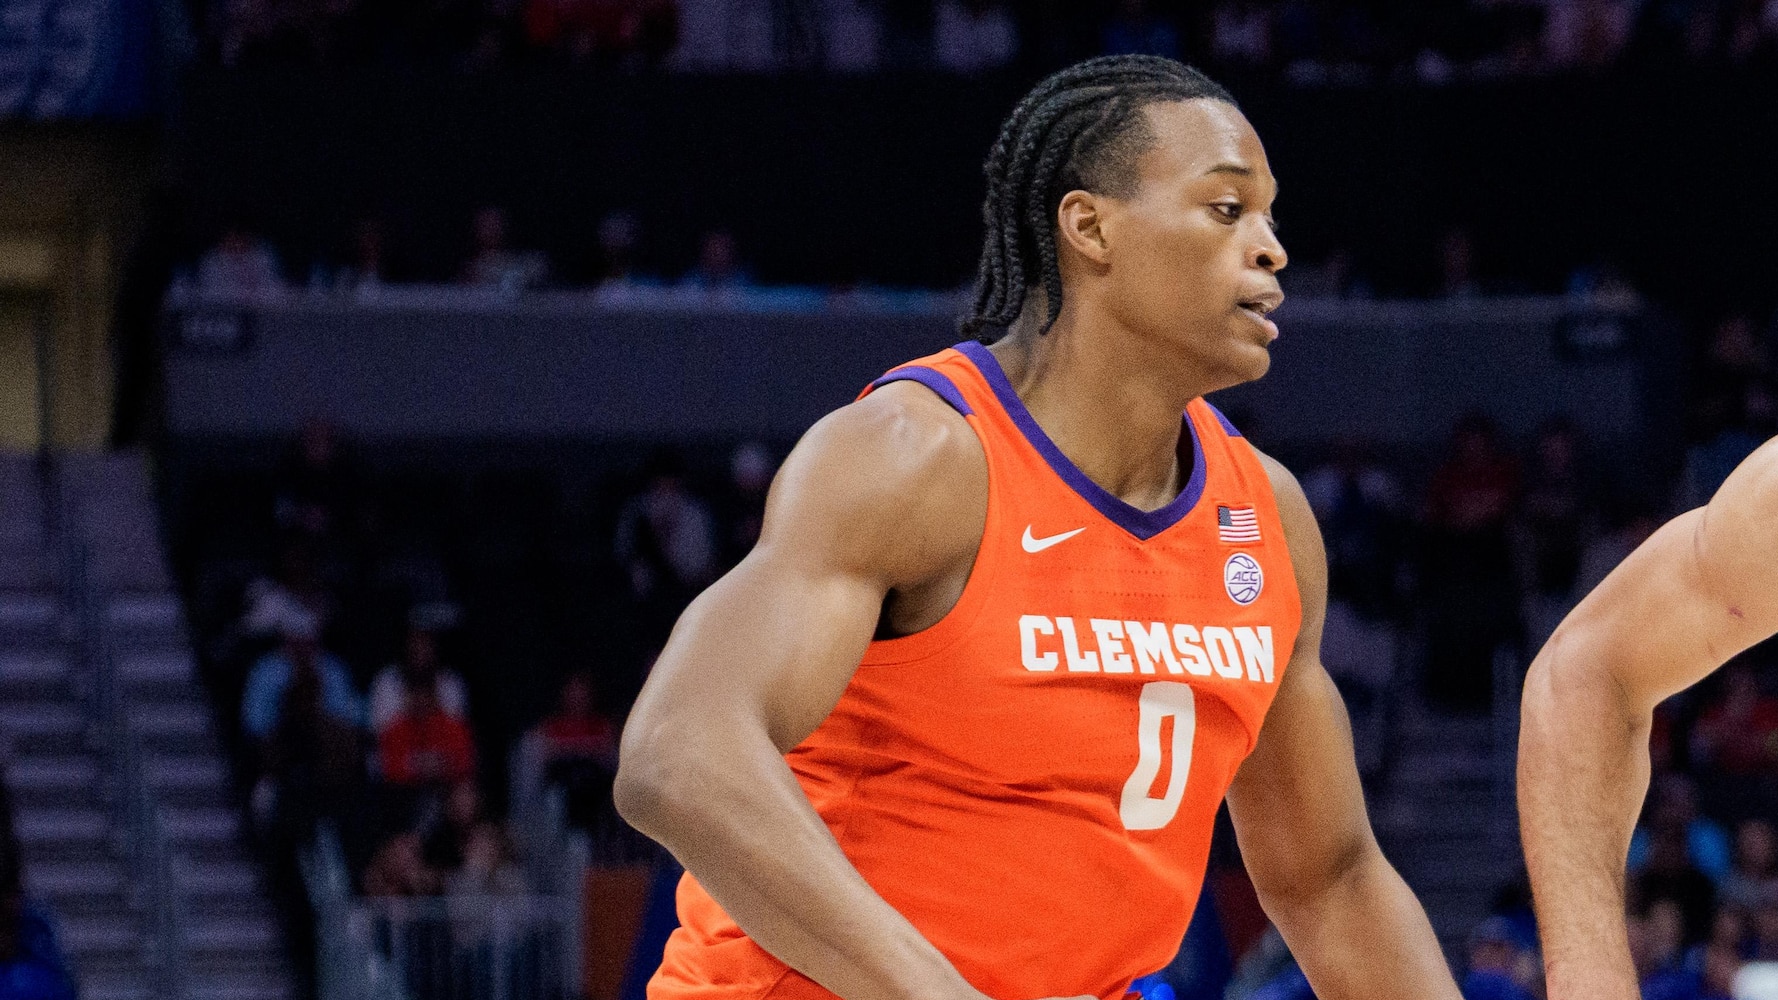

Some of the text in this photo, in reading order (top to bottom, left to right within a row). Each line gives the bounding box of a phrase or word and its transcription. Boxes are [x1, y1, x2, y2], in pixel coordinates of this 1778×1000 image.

[1231, 571, 1259, 582] ACC
[1018, 614, 1275, 684] CLEMSON
[1119, 681, 1196, 831] 0
